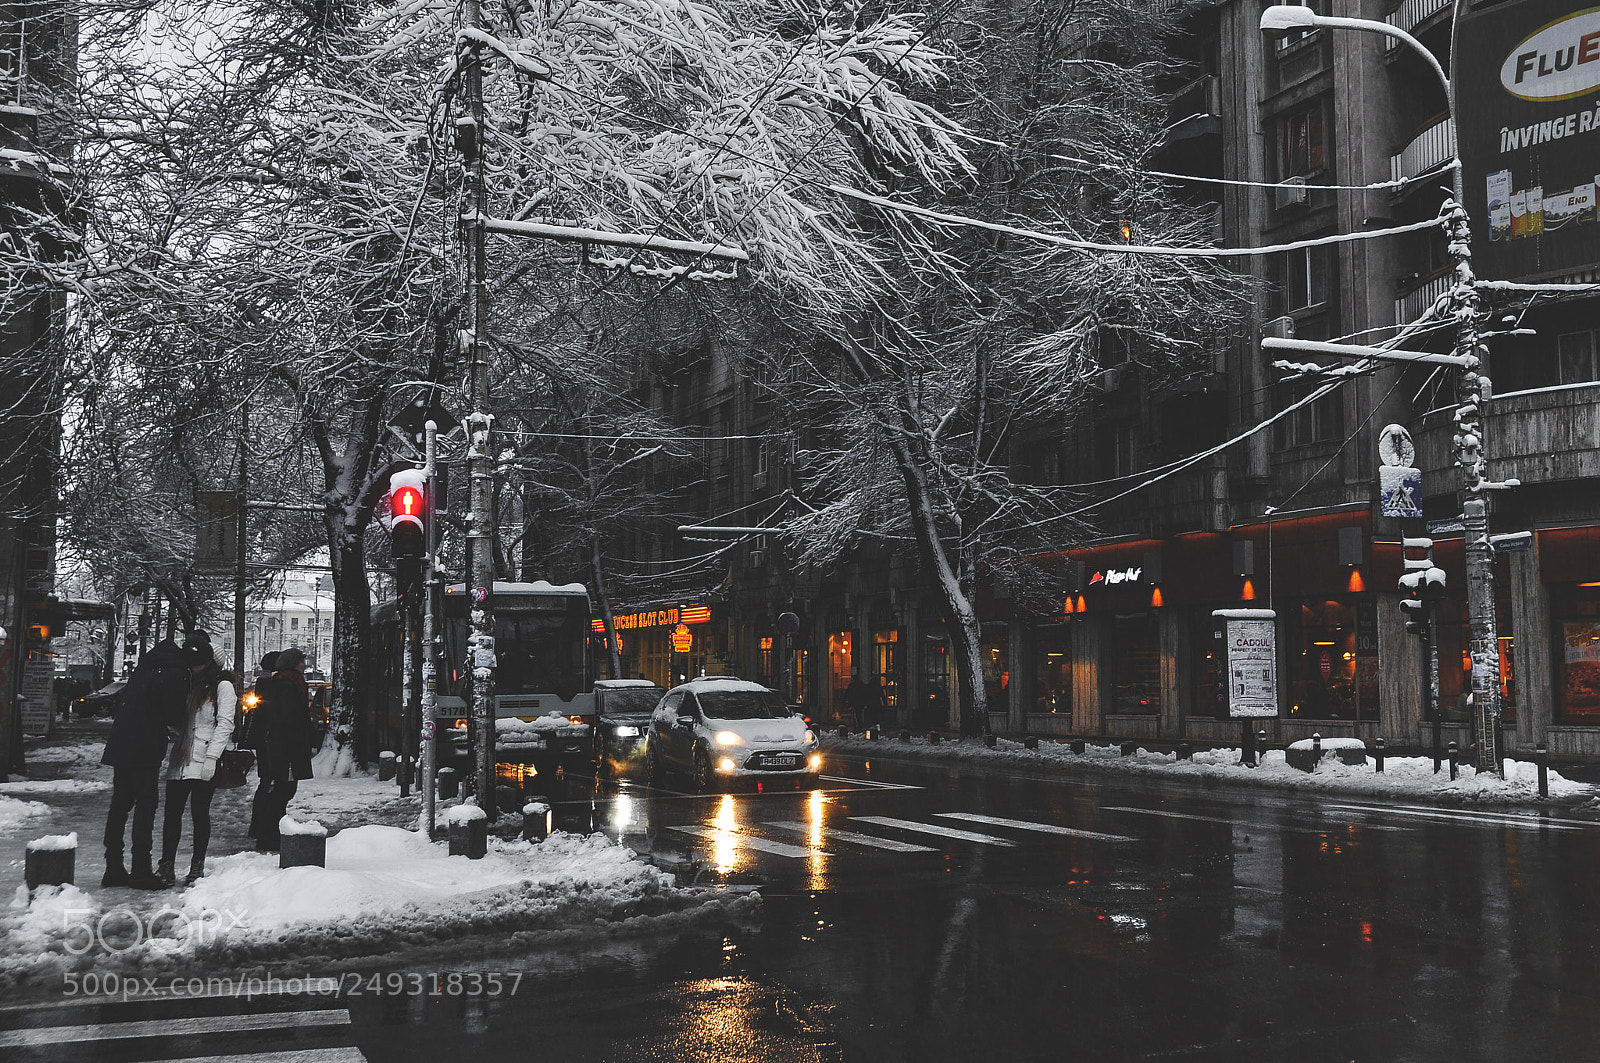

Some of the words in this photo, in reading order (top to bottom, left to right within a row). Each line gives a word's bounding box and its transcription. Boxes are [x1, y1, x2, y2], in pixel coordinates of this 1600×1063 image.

[1500, 113, 1577, 154] ÎNVINGE
[638, 611, 657, 628] SLOT
[658, 608, 679, 626] CLUB
[1236, 638, 1270, 647] CADOUL
